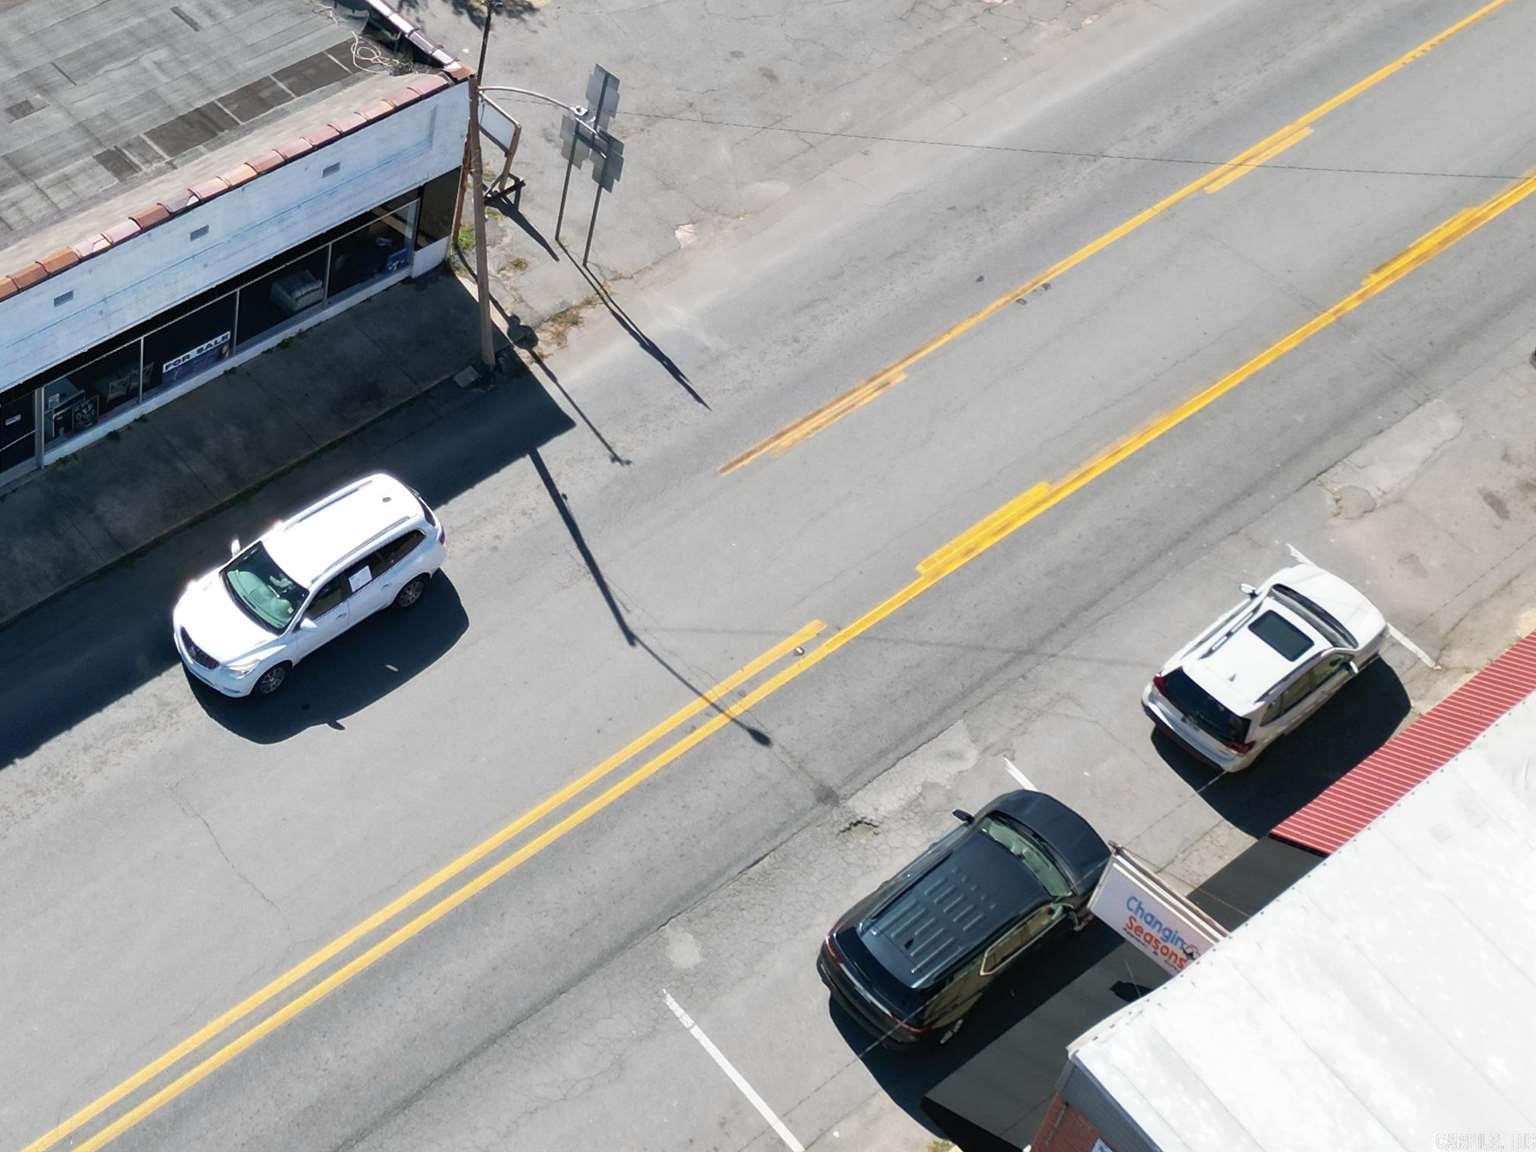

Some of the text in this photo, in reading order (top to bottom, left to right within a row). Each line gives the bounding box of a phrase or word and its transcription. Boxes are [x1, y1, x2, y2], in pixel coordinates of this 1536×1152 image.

[165, 333, 229, 370] FOR SALE
[1126, 915, 1188, 969] Seasons
